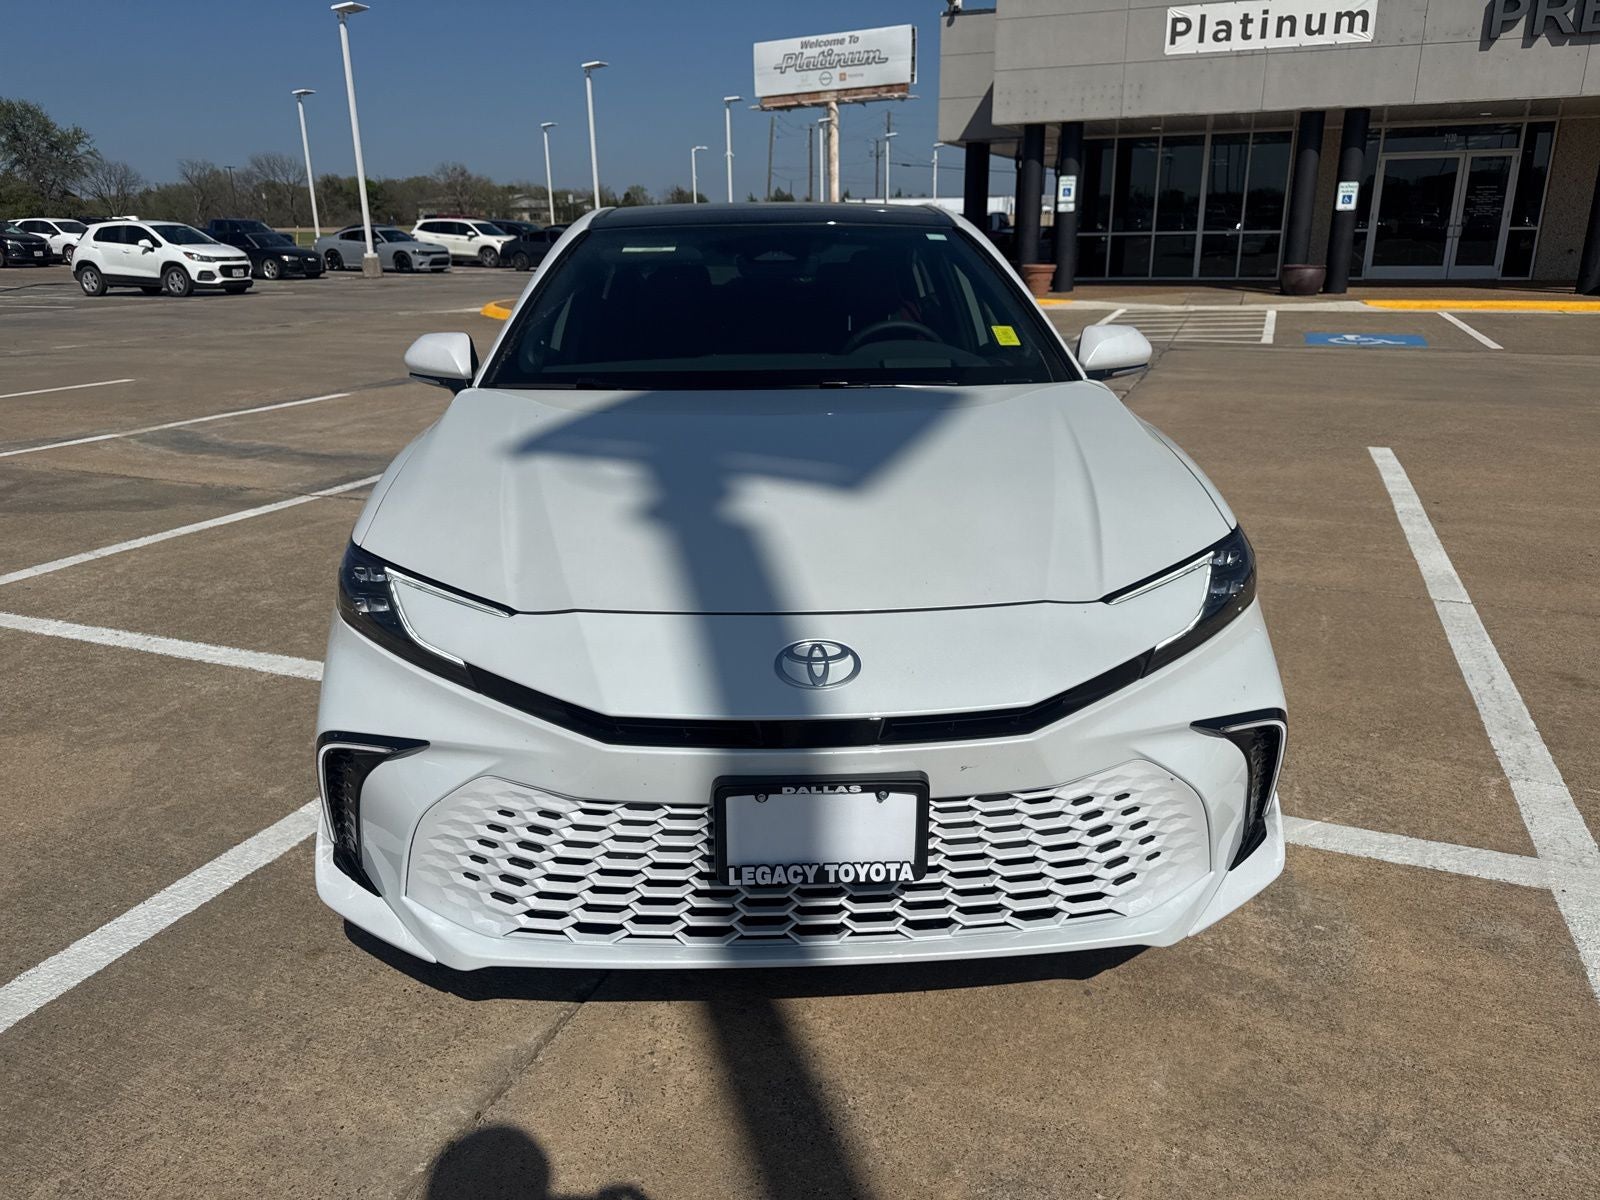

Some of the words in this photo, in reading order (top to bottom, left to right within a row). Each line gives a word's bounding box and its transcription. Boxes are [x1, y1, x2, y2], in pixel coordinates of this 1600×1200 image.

[1169, 8, 1370, 46] Platinum
[1490, 0, 1600, 39] PRE
[800, 38, 846, 50] Welcome
[848, 34, 860, 45] To
[773, 48, 889, 75] Platinum
[781, 785, 862, 795] DALLAS
[728, 864, 818, 886] LEGACY
[824, 861, 914, 883] TOYOTA
